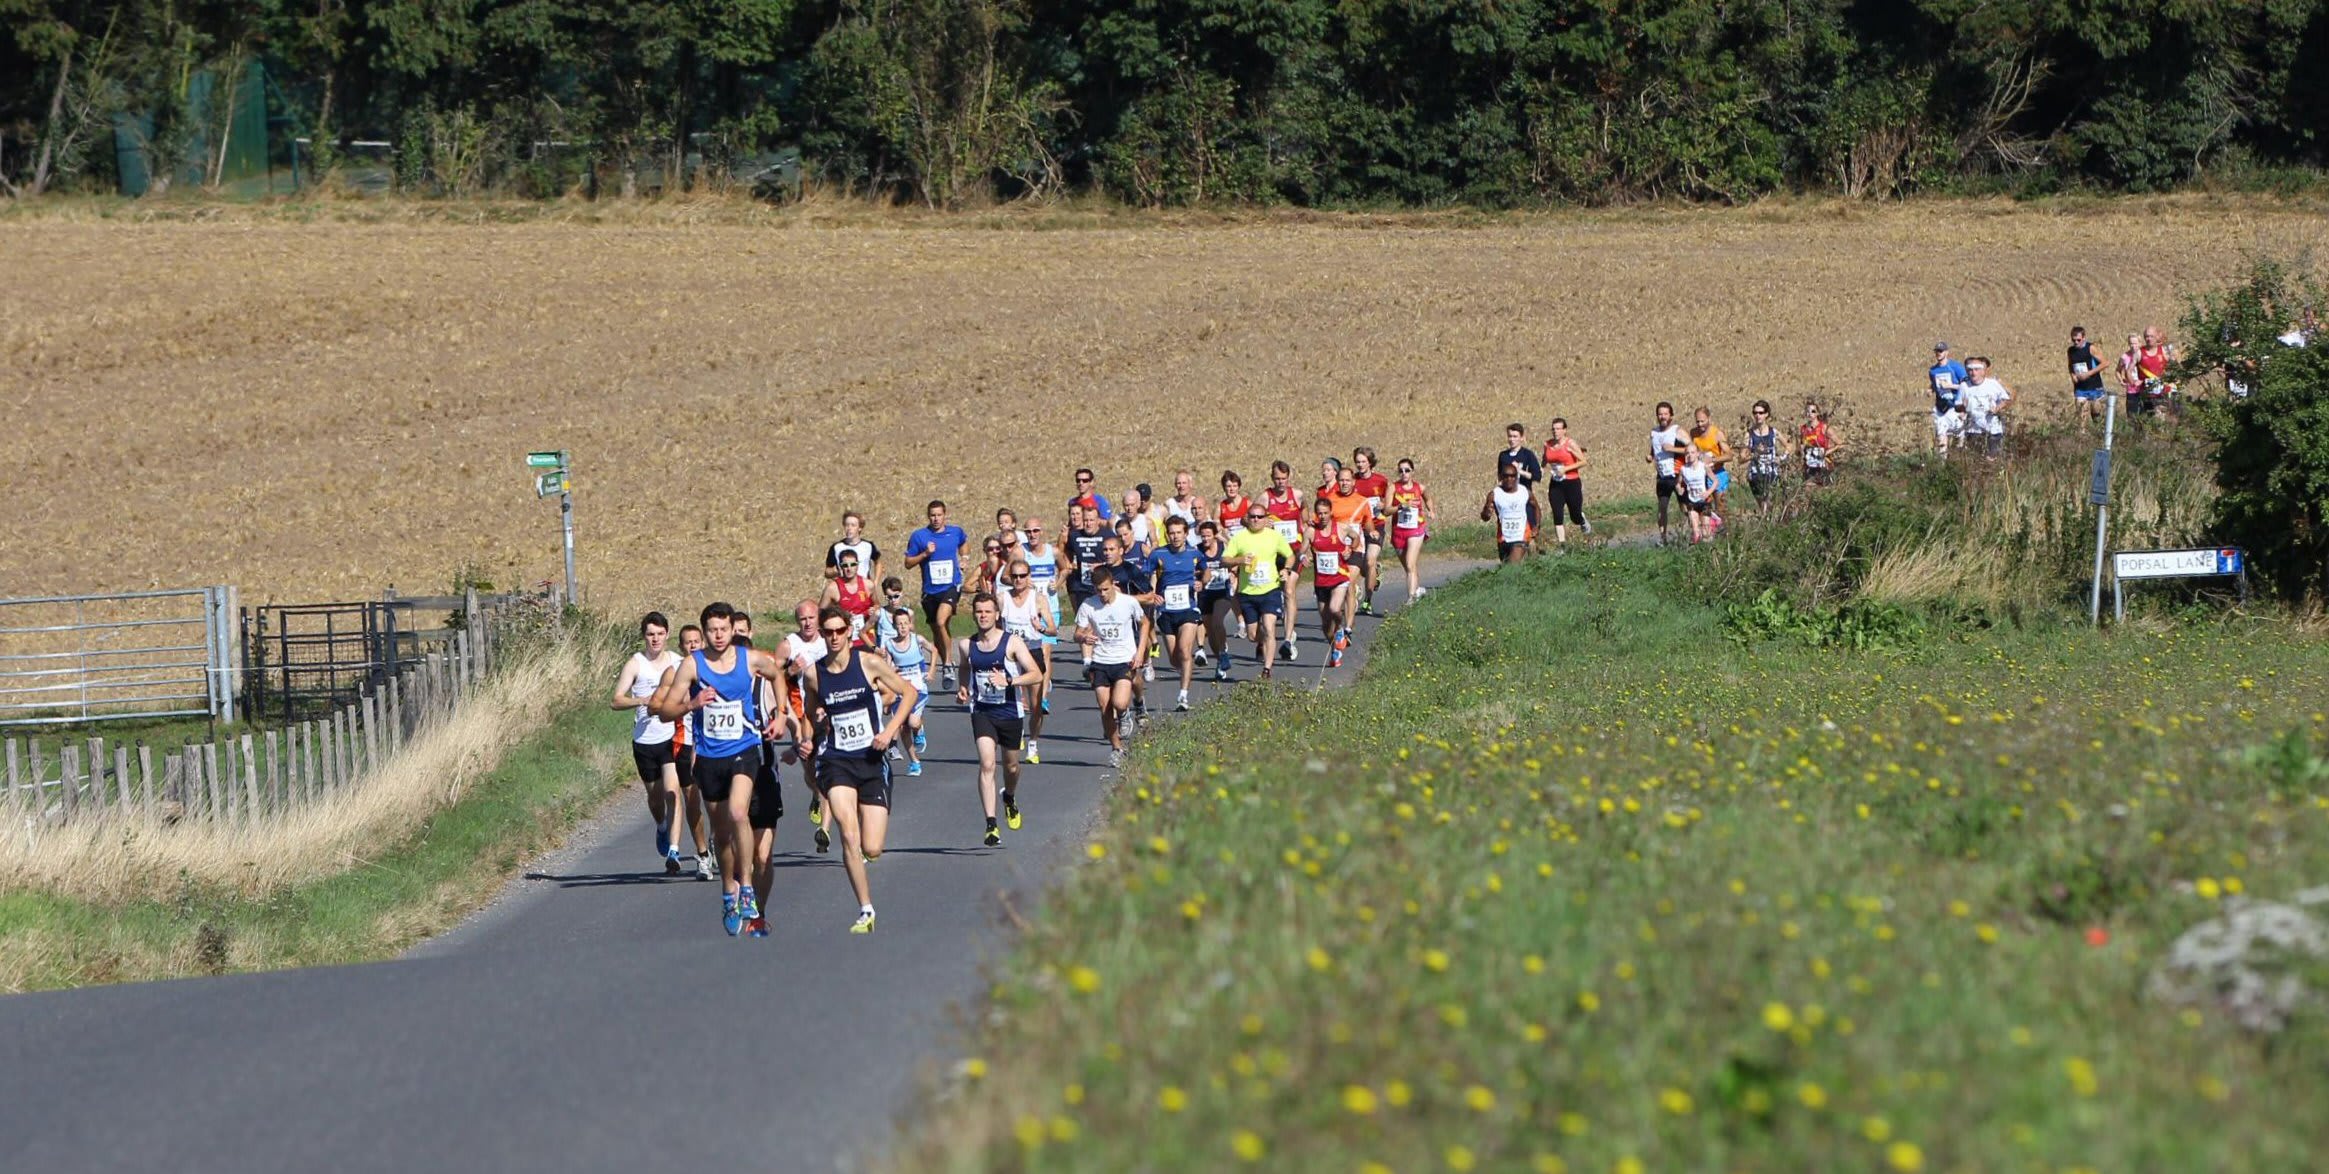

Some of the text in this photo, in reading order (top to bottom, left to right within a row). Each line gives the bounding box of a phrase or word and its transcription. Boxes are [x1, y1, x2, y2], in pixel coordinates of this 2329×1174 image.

[2121, 556, 2213, 570] POPSAL LANE
[1101, 628, 1120, 638] 363
[833, 687, 866, 698] Canterbury
[709, 713, 735, 728] 370
[839, 722, 866, 740] 383
